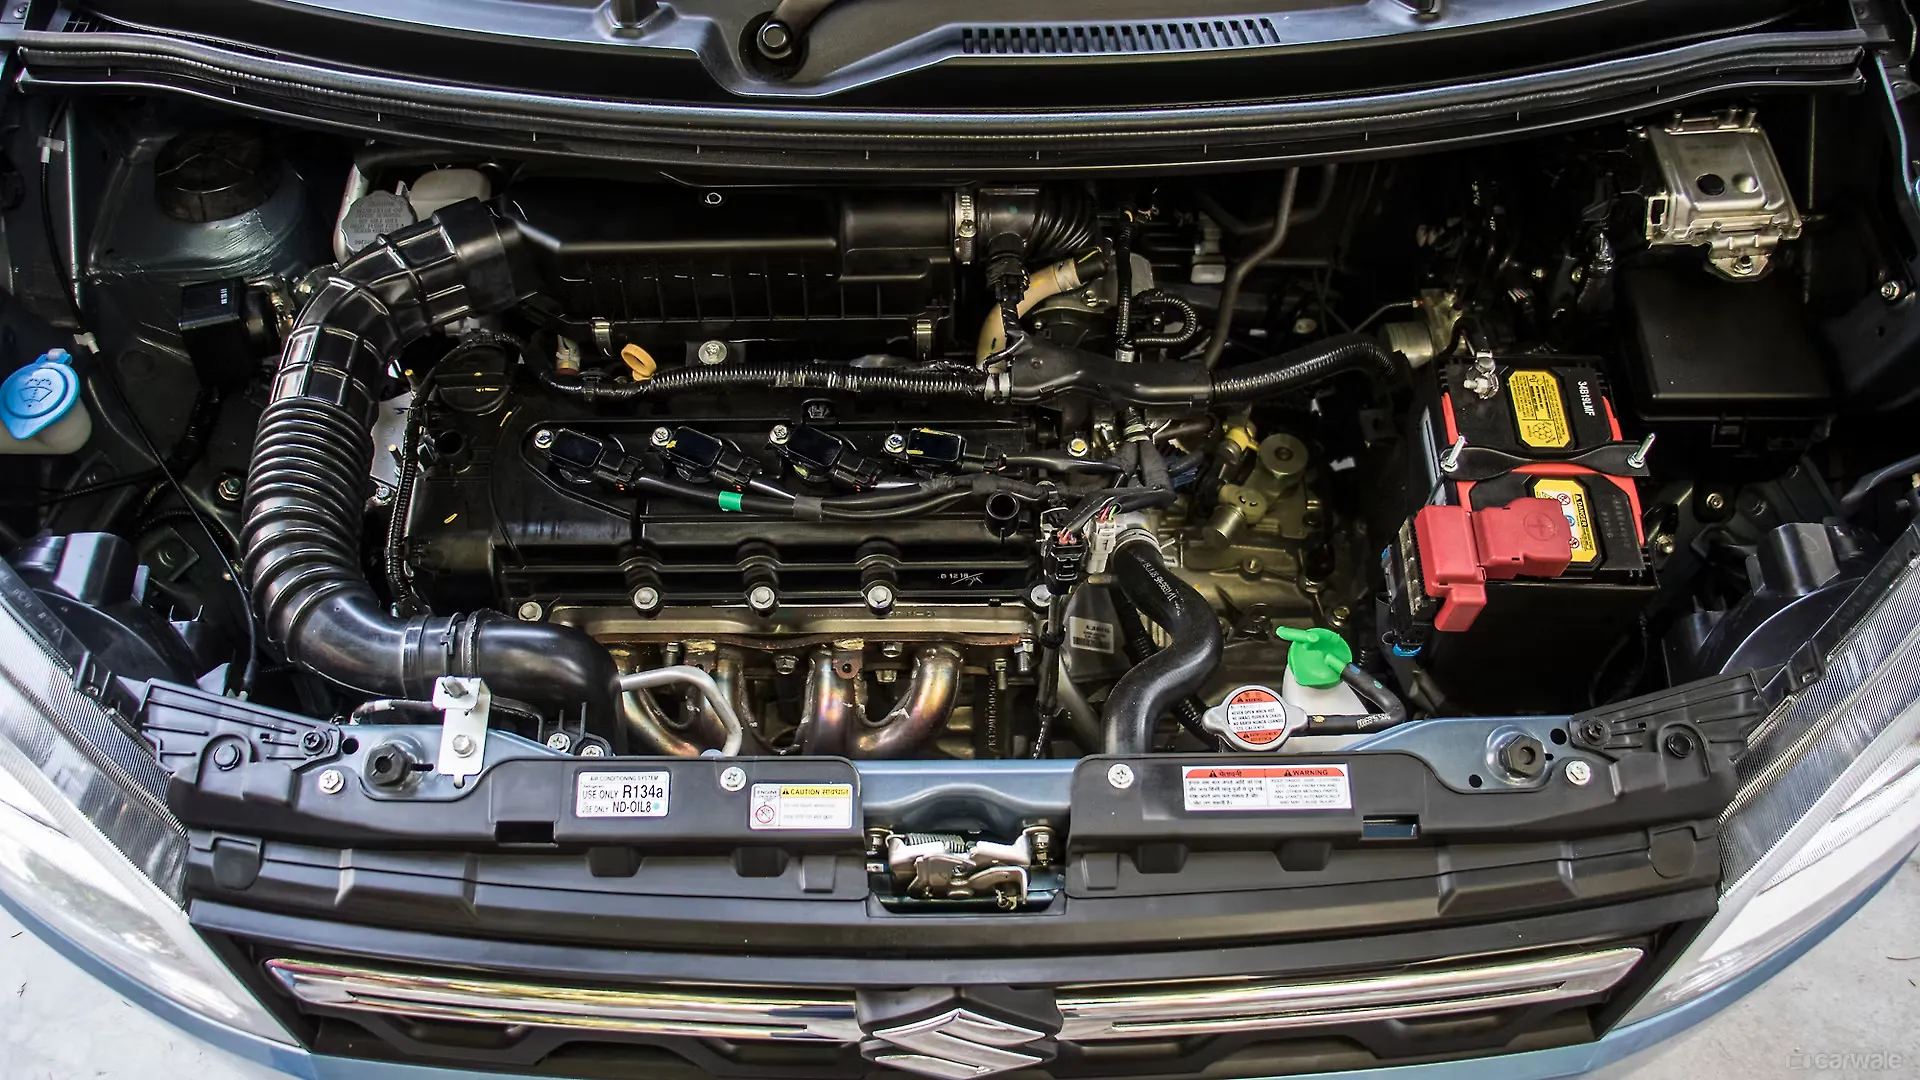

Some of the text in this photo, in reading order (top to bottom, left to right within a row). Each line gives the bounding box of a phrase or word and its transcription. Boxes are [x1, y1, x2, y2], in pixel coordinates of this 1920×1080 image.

[1577, 501, 1588, 528] DANGER
[582, 784, 663, 800] USE ONLY R134a
[612, 800, 652, 813] ND-OIL8
